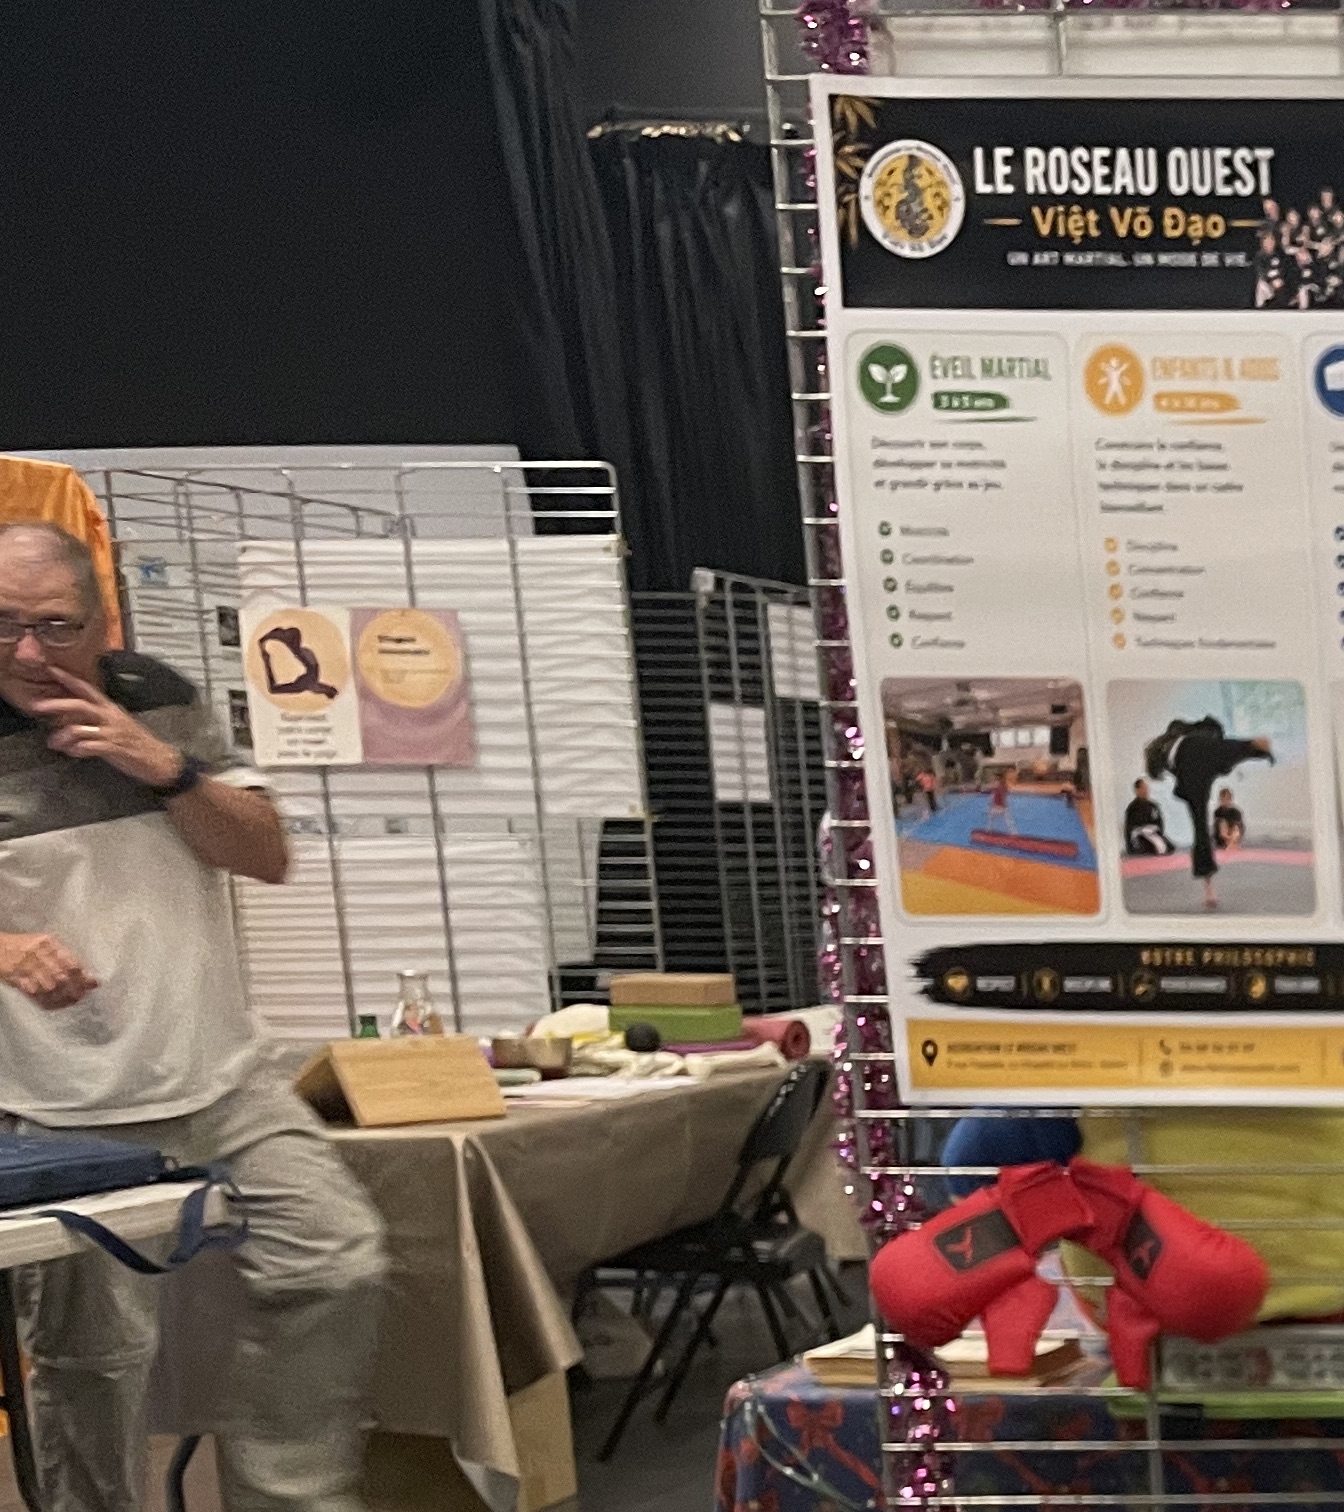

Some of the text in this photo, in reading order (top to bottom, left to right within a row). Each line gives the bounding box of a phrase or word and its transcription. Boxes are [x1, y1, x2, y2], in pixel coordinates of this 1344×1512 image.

[974, 146, 1274, 196] LE ROSEAU OUEST
[1031, 204, 1101, 245] Việt
